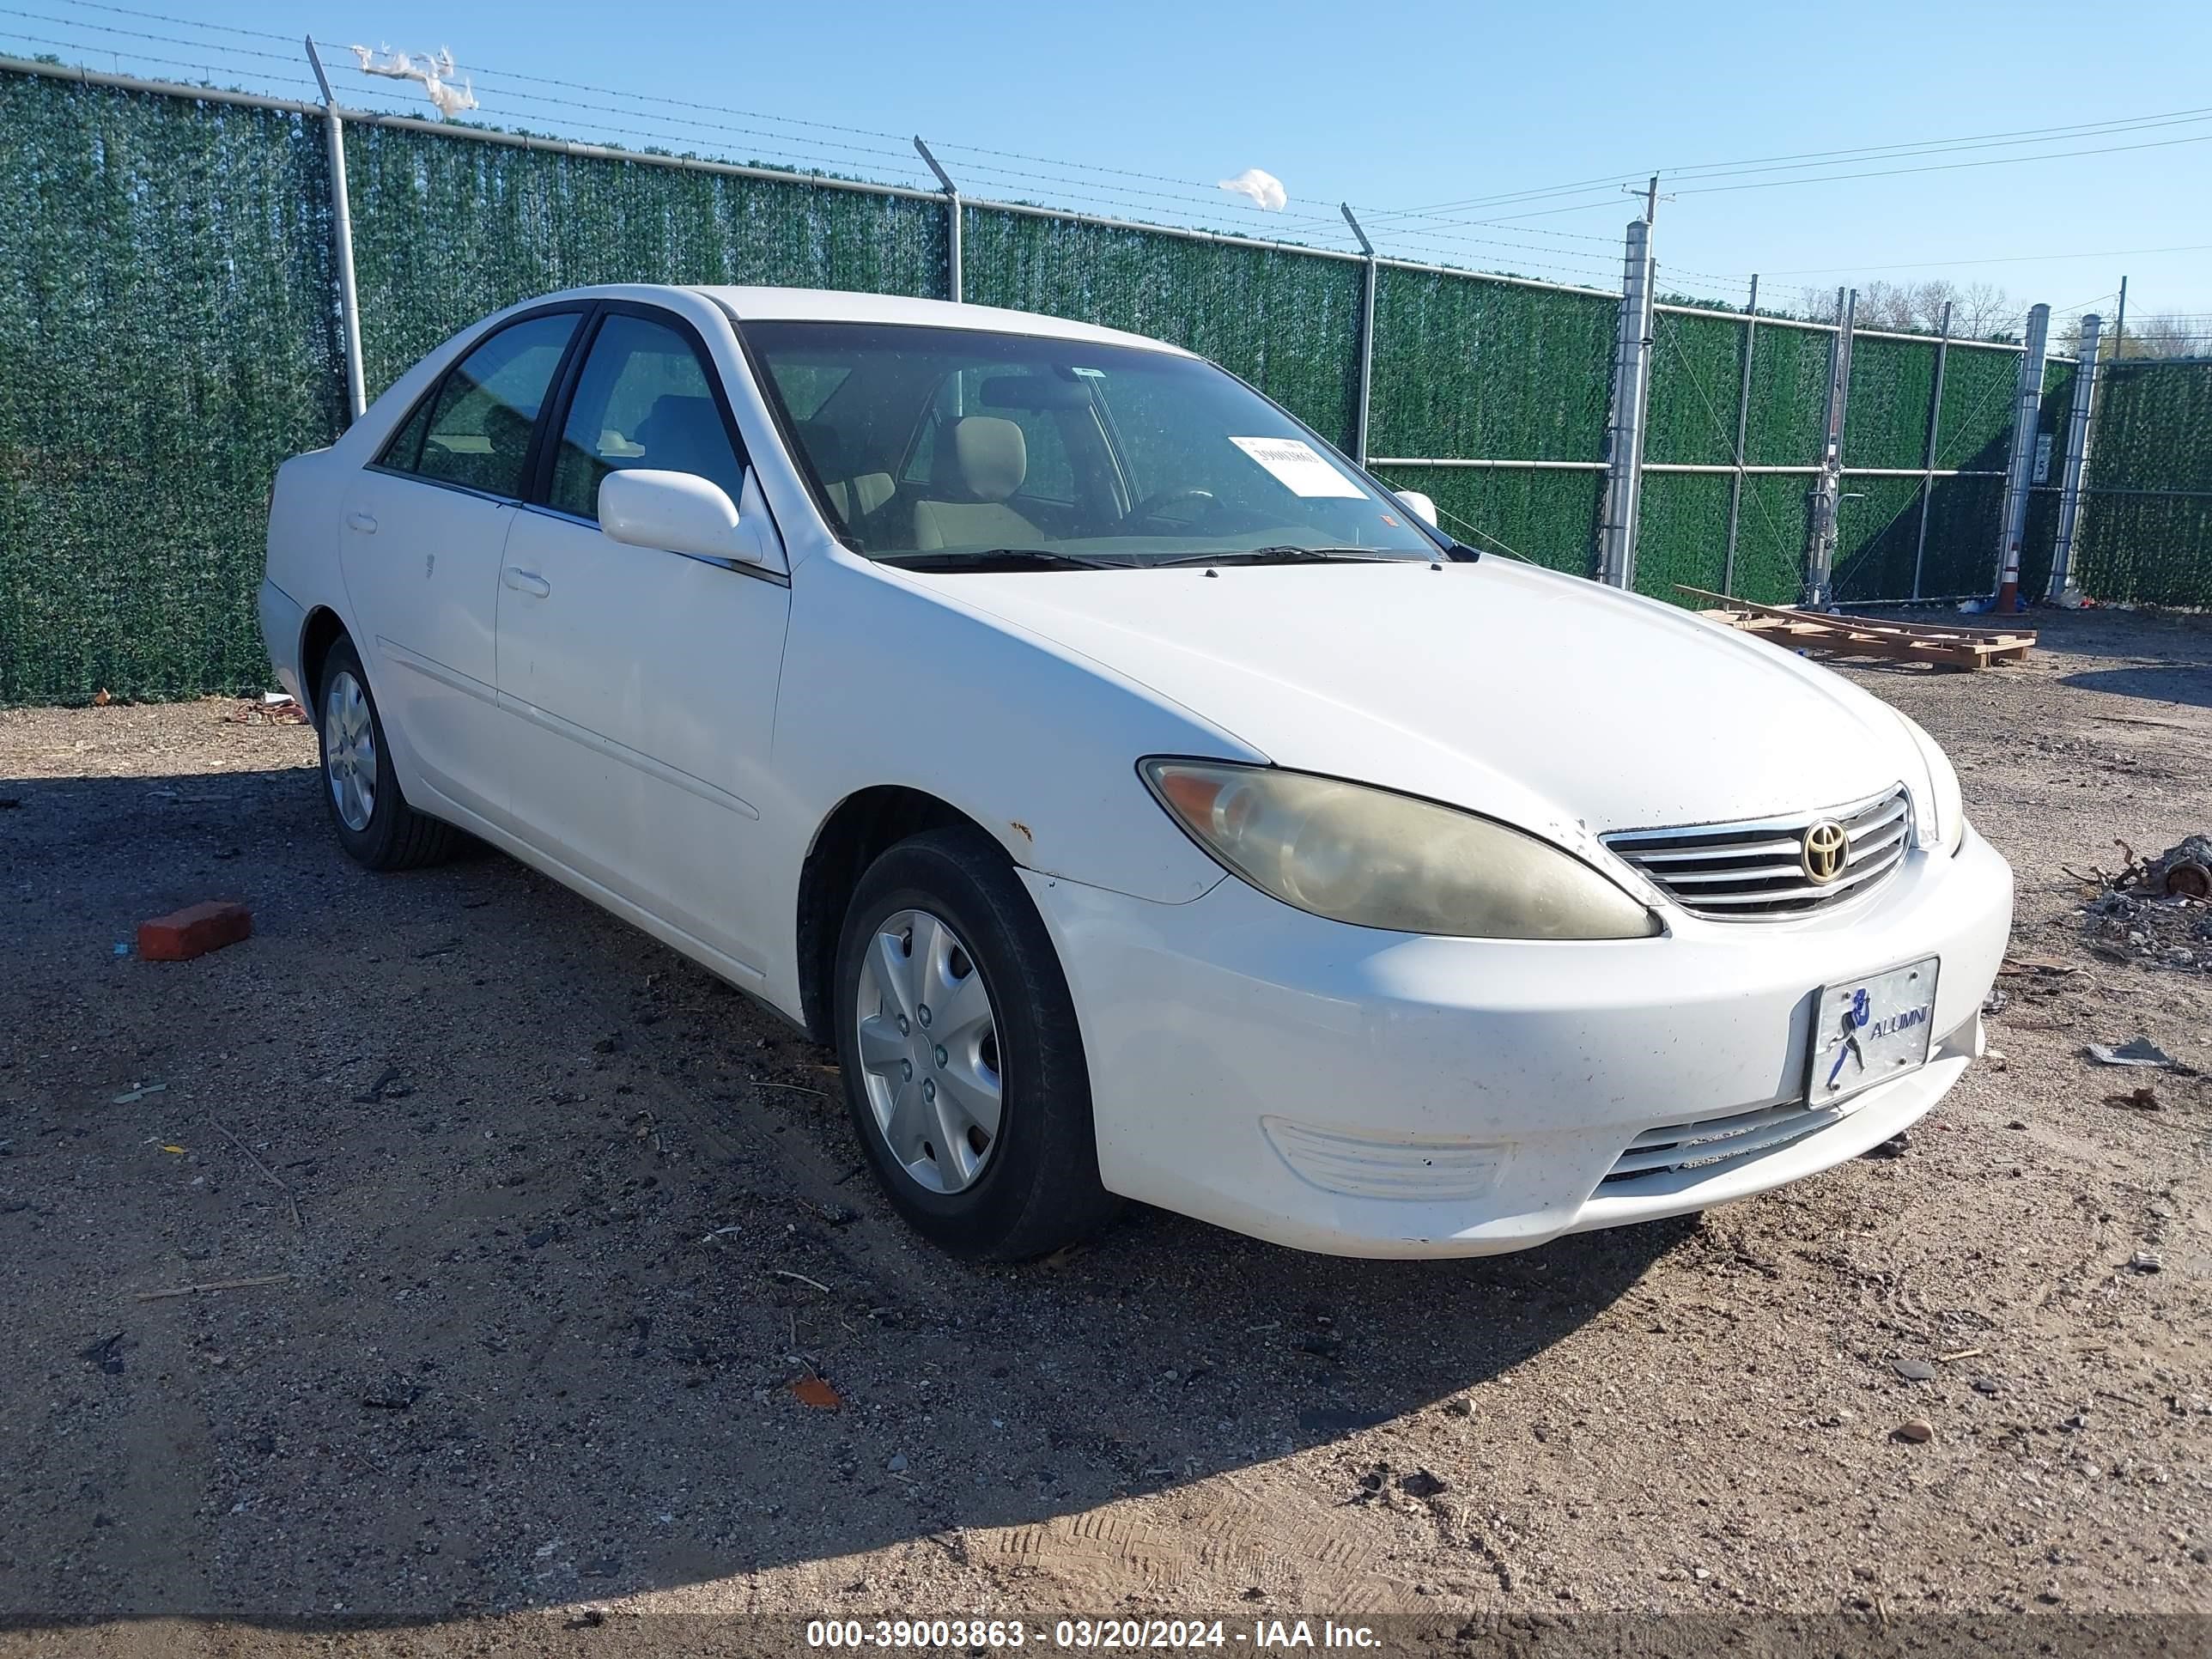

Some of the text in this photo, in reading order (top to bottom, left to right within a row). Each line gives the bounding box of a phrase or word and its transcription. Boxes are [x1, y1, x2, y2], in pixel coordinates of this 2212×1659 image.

[1254, 450, 1319, 463] 39003863
[2039, 460, 2045, 475] 5
[1869, 1005, 1929, 1041] ALUMNI
